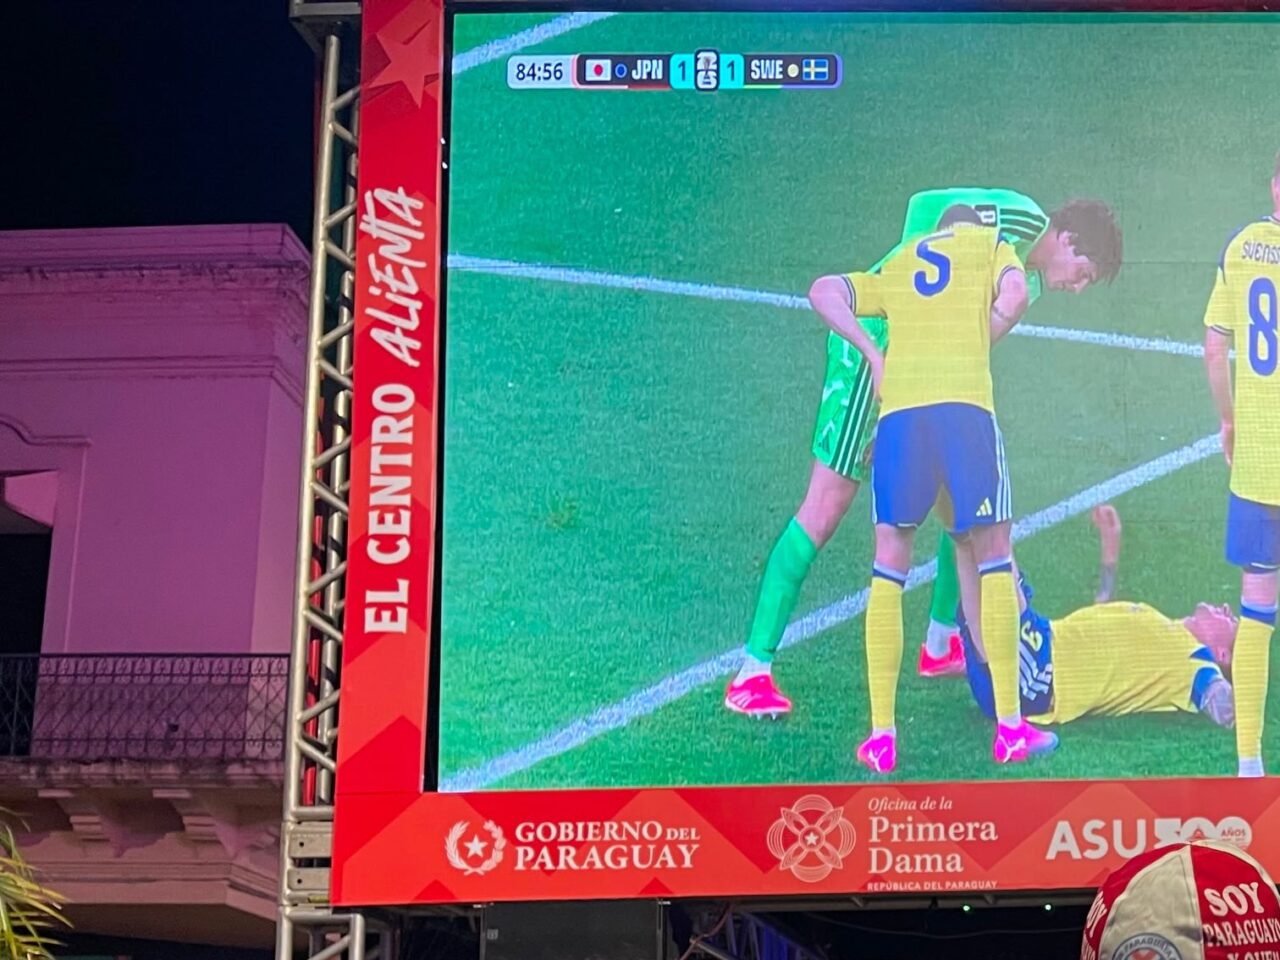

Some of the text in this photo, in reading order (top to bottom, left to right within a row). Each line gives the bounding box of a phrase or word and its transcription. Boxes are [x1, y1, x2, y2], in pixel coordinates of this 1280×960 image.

[516, 62, 564, 82] 84:56
[631, 59, 663, 80] JPN
[678, 60, 686, 82] 1
[727, 60, 735, 82] 1
[750, 59, 784, 79] SWE
[914, 231, 953, 297] 5
[1248, 276, 1278, 376] 8
[366, 383, 415, 565] CENTRO
[365, 579, 409, 634] EL
[868, 796, 953, 815] Oficina de la
[515, 821, 700, 843] GOBIERNO DEL
[868, 815, 999, 843] Primera
[1221, 826, 1246, 838] AÑOS
[514, 844, 700, 871] PARAGUAY
[867, 846, 965, 874] Dama
[867, 880, 998, 892] REPÚBLICA DEL PARAGUAY
[1203, 881, 1265, 917] SOY
